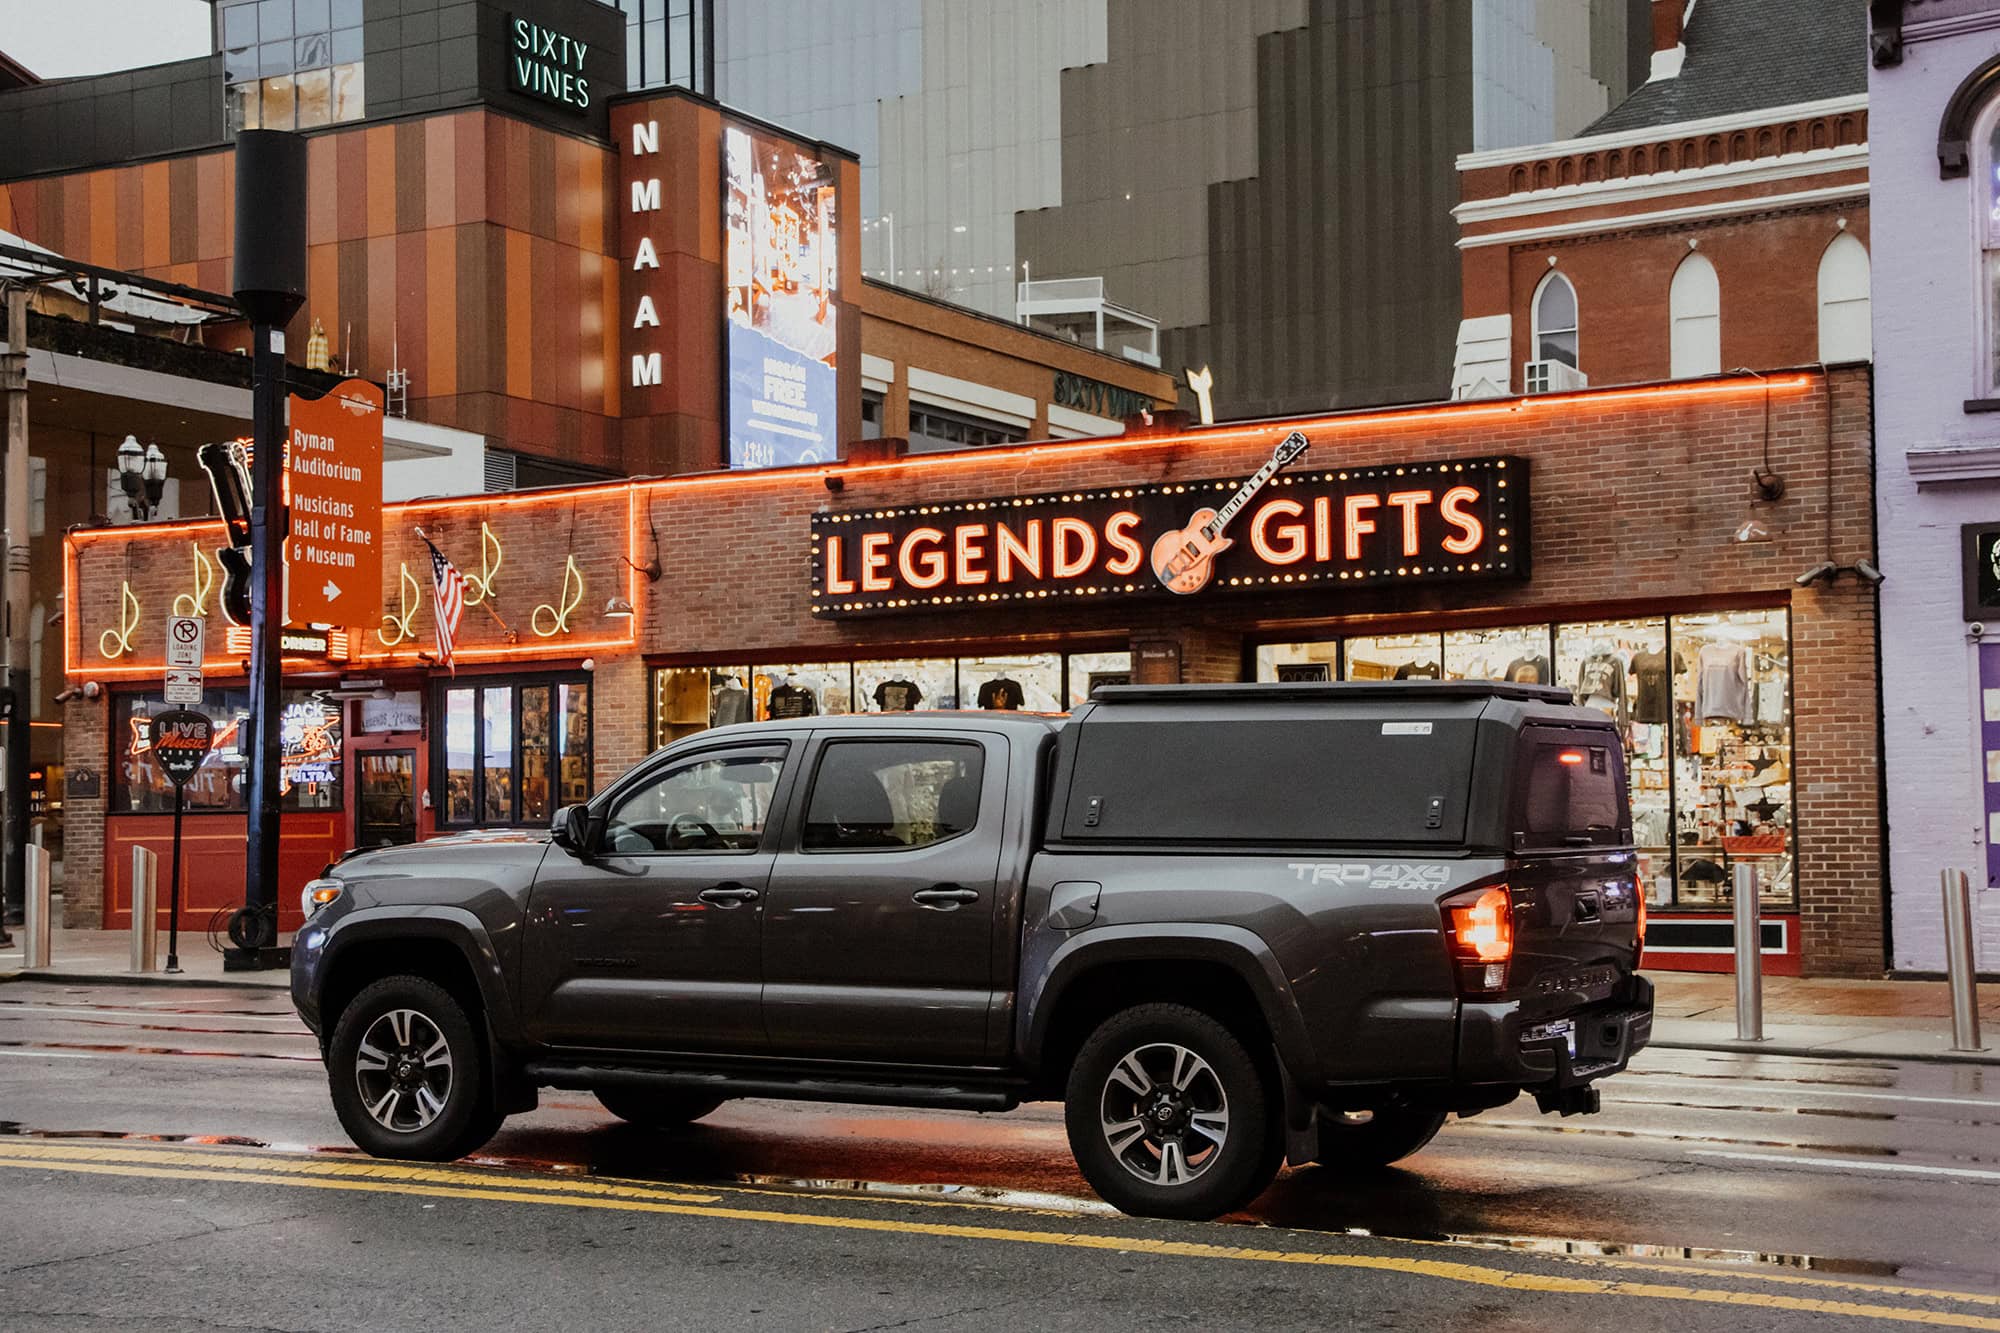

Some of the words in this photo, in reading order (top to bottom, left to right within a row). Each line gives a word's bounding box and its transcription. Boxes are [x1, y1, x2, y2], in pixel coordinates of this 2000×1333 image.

[514, 19, 588, 70] SIXTY
[515, 55, 590, 108] VINES
[632, 120, 662, 388] NMAAM
[1054, 369, 1107, 414] SIXTY
[294, 428, 335, 452] Ryman
[294, 455, 362, 483] Auditorium
[294, 494, 355, 519] Musicians
[294, 519, 319, 540] Hall
[323, 522, 336, 541] of
[340, 525, 371, 545] Fame
[826, 511, 1144, 595] LEGENDS
[1250, 485, 1485, 566] GIFTS
[294, 543, 302, 561] &
[306, 545, 356, 568] Museum
[172, 644, 198, 652] LOADING
[177, 651, 193, 659] ZONE
[281, 635, 327, 652] ORNER
[283, 701, 324, 719] JACK
[154, 730, 209, 750] Music
[159, 721, 208, 739] LIVE
[291, 770, 337, 784] ULTRA
[1287, 863, 1371, 887] TRD
[1368, 879, 1448, 891] SPORT
